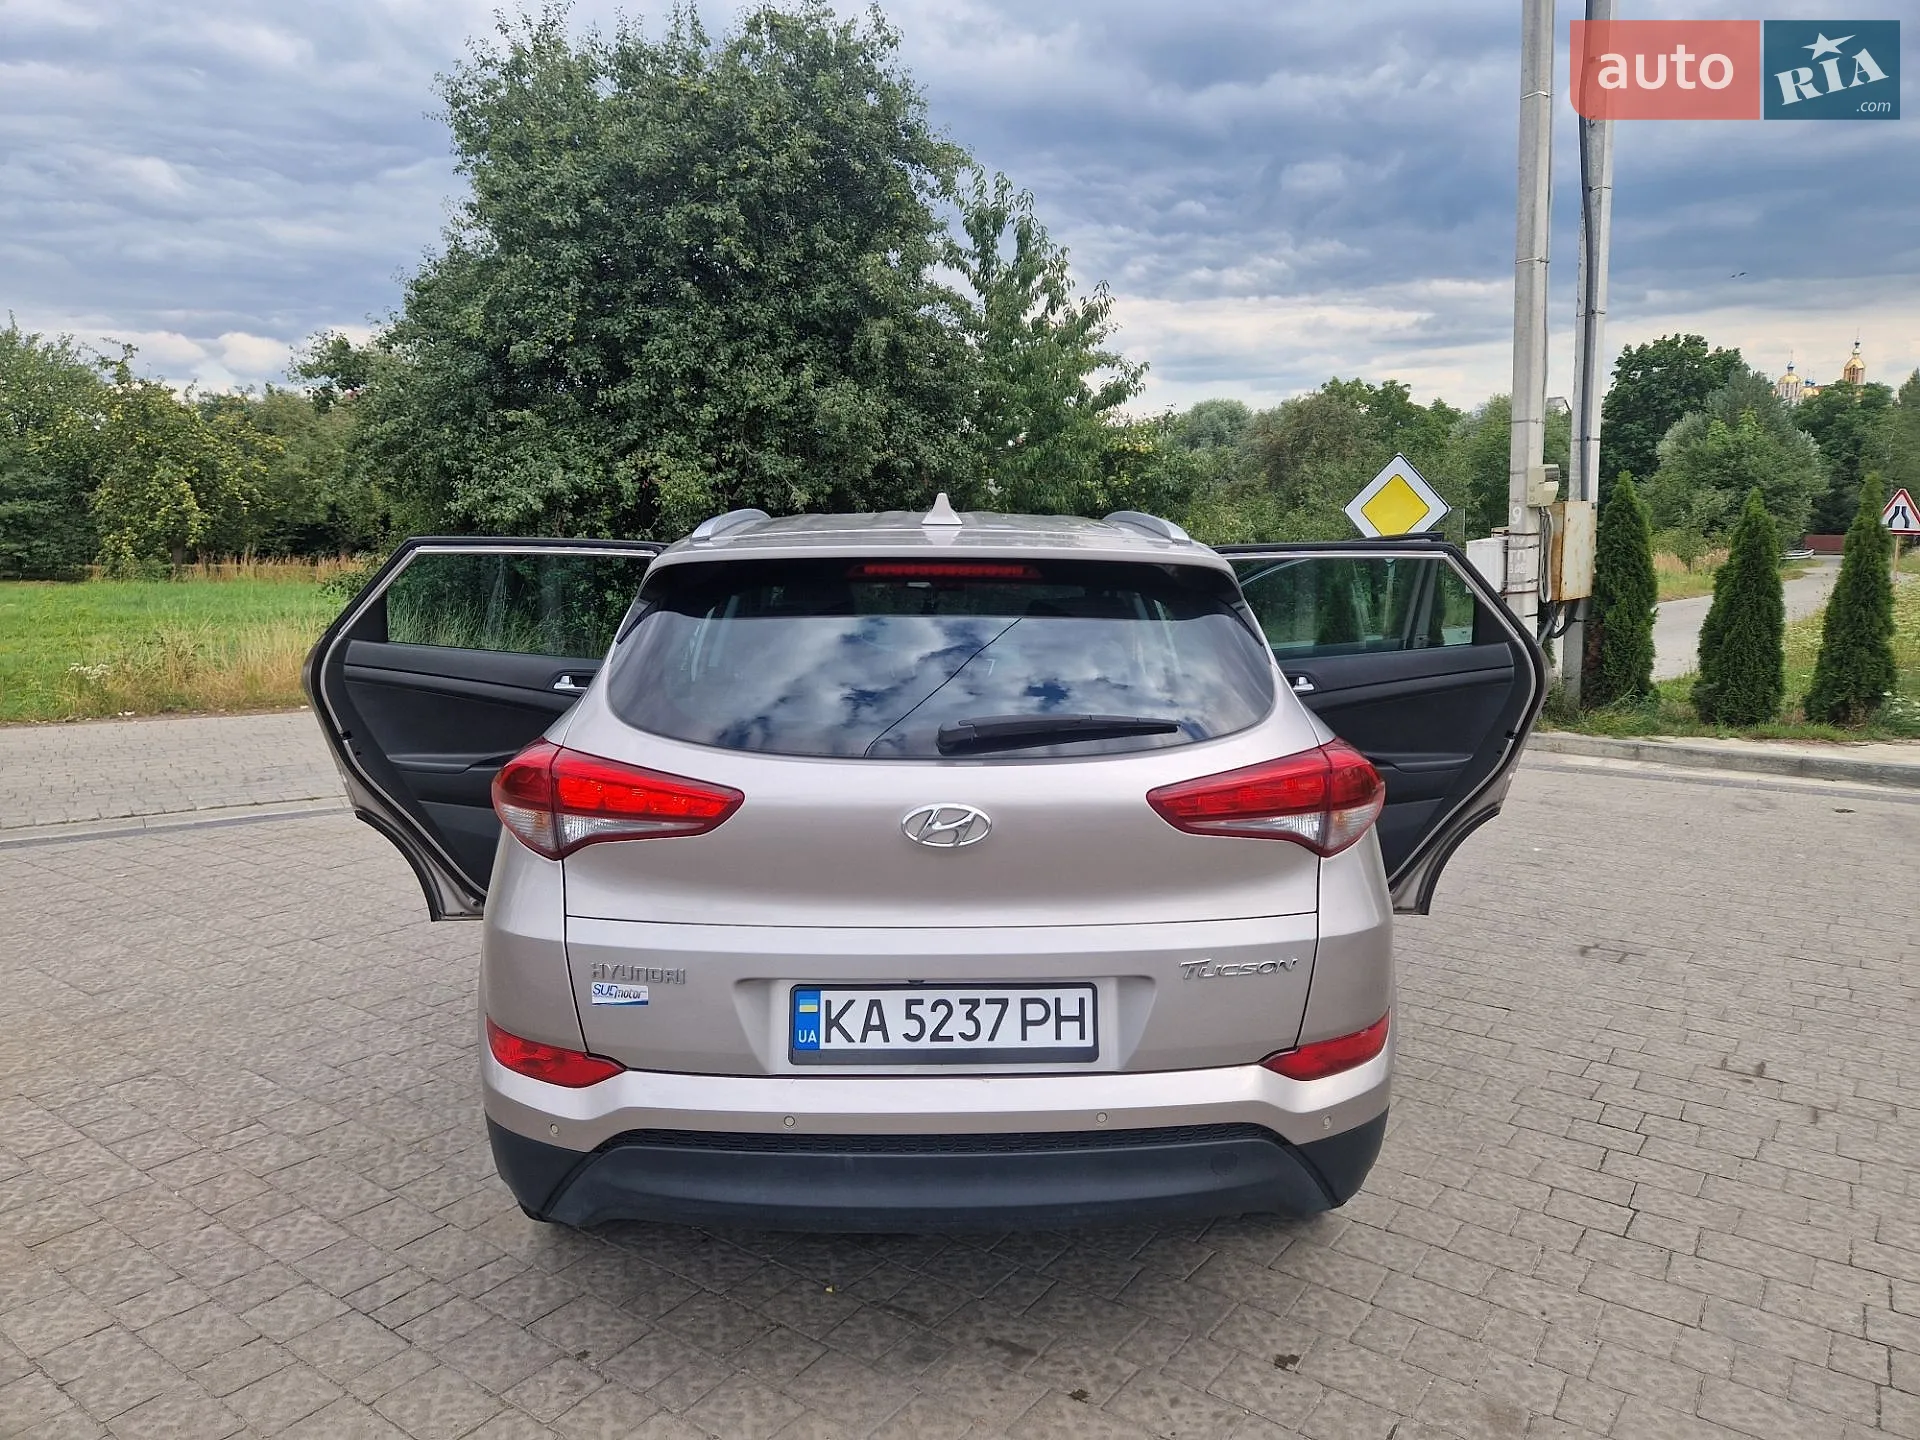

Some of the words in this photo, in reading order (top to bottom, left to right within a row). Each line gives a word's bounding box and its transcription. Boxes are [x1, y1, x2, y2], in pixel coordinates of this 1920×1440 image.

[591, 962, 686, 985] HYUNDAI
[824, 999, 890, 1043] KA
[902, 998, 1010, 1042] 5237
[1020, 997, 1086, 1041] PH
[798, 1029, 817, 1043] UA
